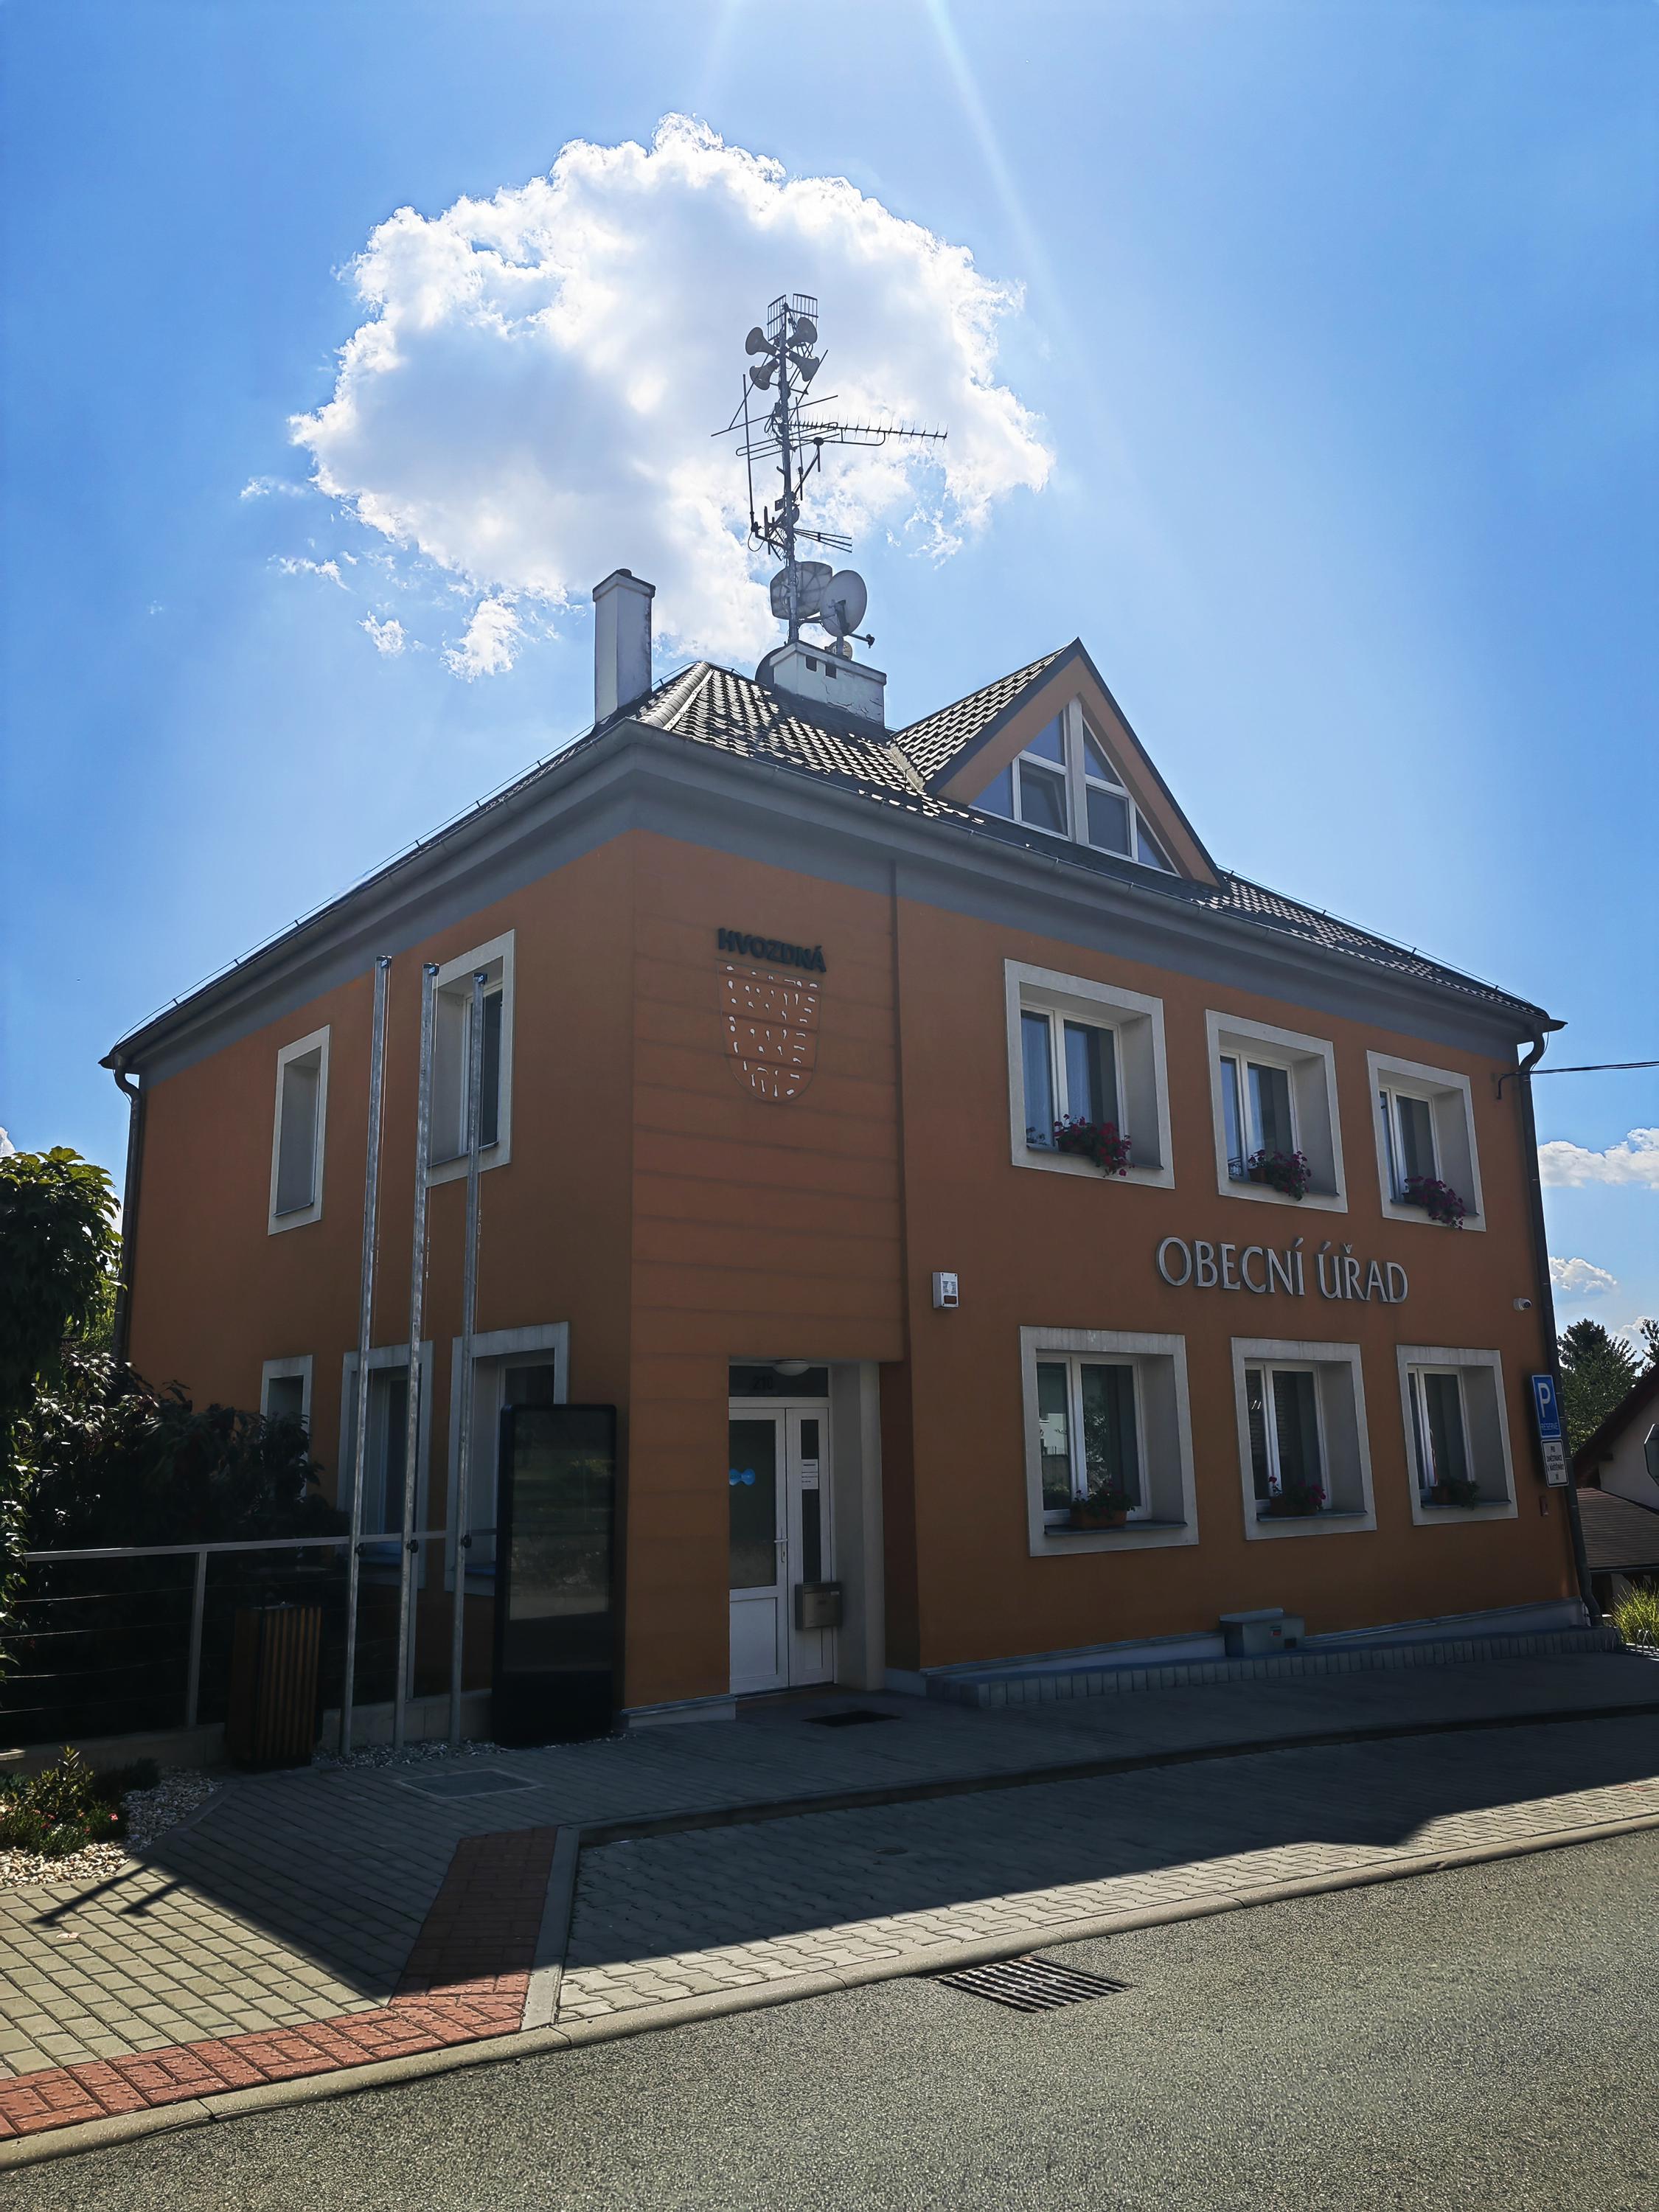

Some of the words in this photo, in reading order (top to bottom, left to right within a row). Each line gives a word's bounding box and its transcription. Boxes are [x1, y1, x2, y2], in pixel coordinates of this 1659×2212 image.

[717, 928, 827, 973] HVOZDNÁ
[1156, 1237, 1305, 1295] OBECNÍ
[1315, 1240, 1409, 1304] ÚŘAD
[753, 1375, 773, 1390] 210
[1537, 1382, 1551, 1418] P
